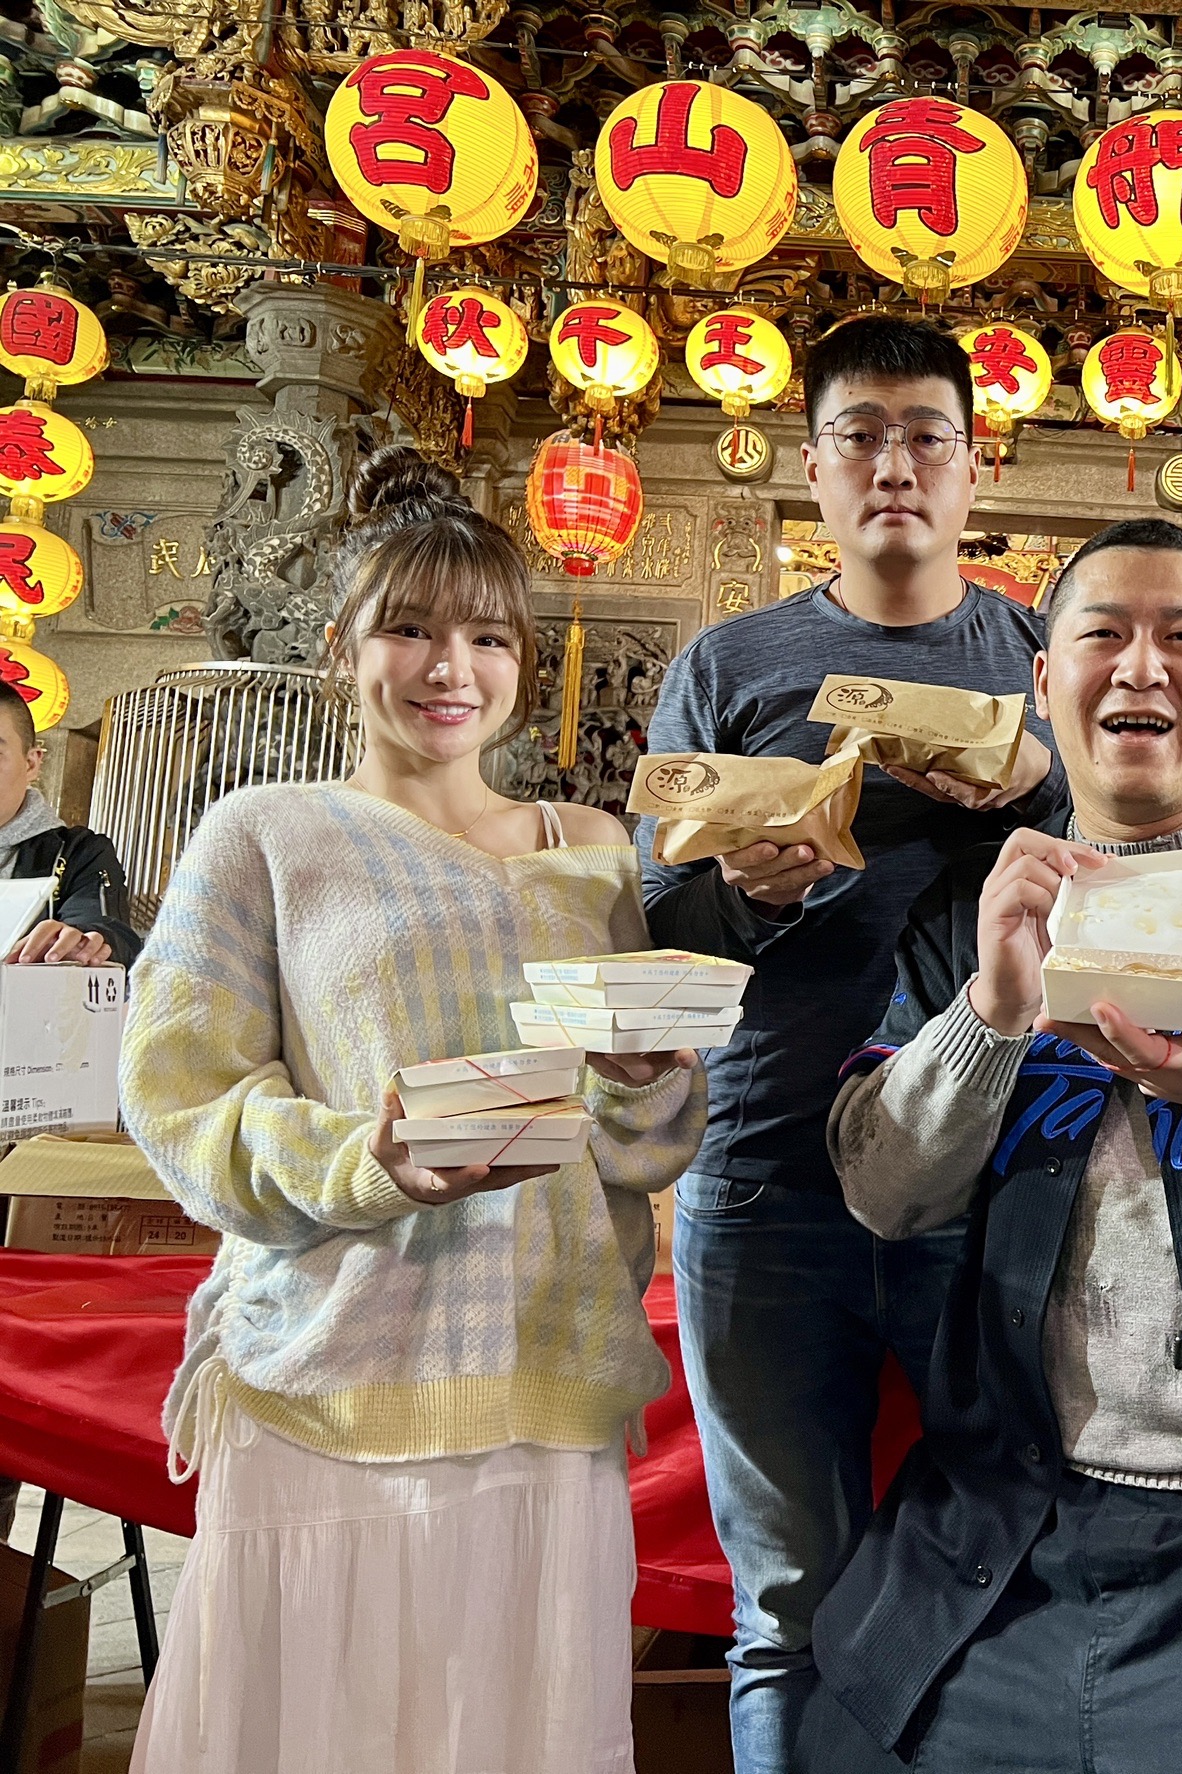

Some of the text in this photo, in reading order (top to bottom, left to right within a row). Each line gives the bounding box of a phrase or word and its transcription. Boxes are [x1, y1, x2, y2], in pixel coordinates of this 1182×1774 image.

[346, 49, 490, 195] 宮
[608, 81, 748, 199] 山
[859, 97, 986, 237] 青
[1, 290, 79, 366] 國
[421, 296, 503, 360] 秋
[558, 306, 633, 368] 千
[700, 313, 757, 376] 王
[972, 328, 1038, 394] 安
[1100, 331, 1163, 406] 靈
[0, 409, 66, 481] 泰
[149, 1230, 187, 1240] 24 20
